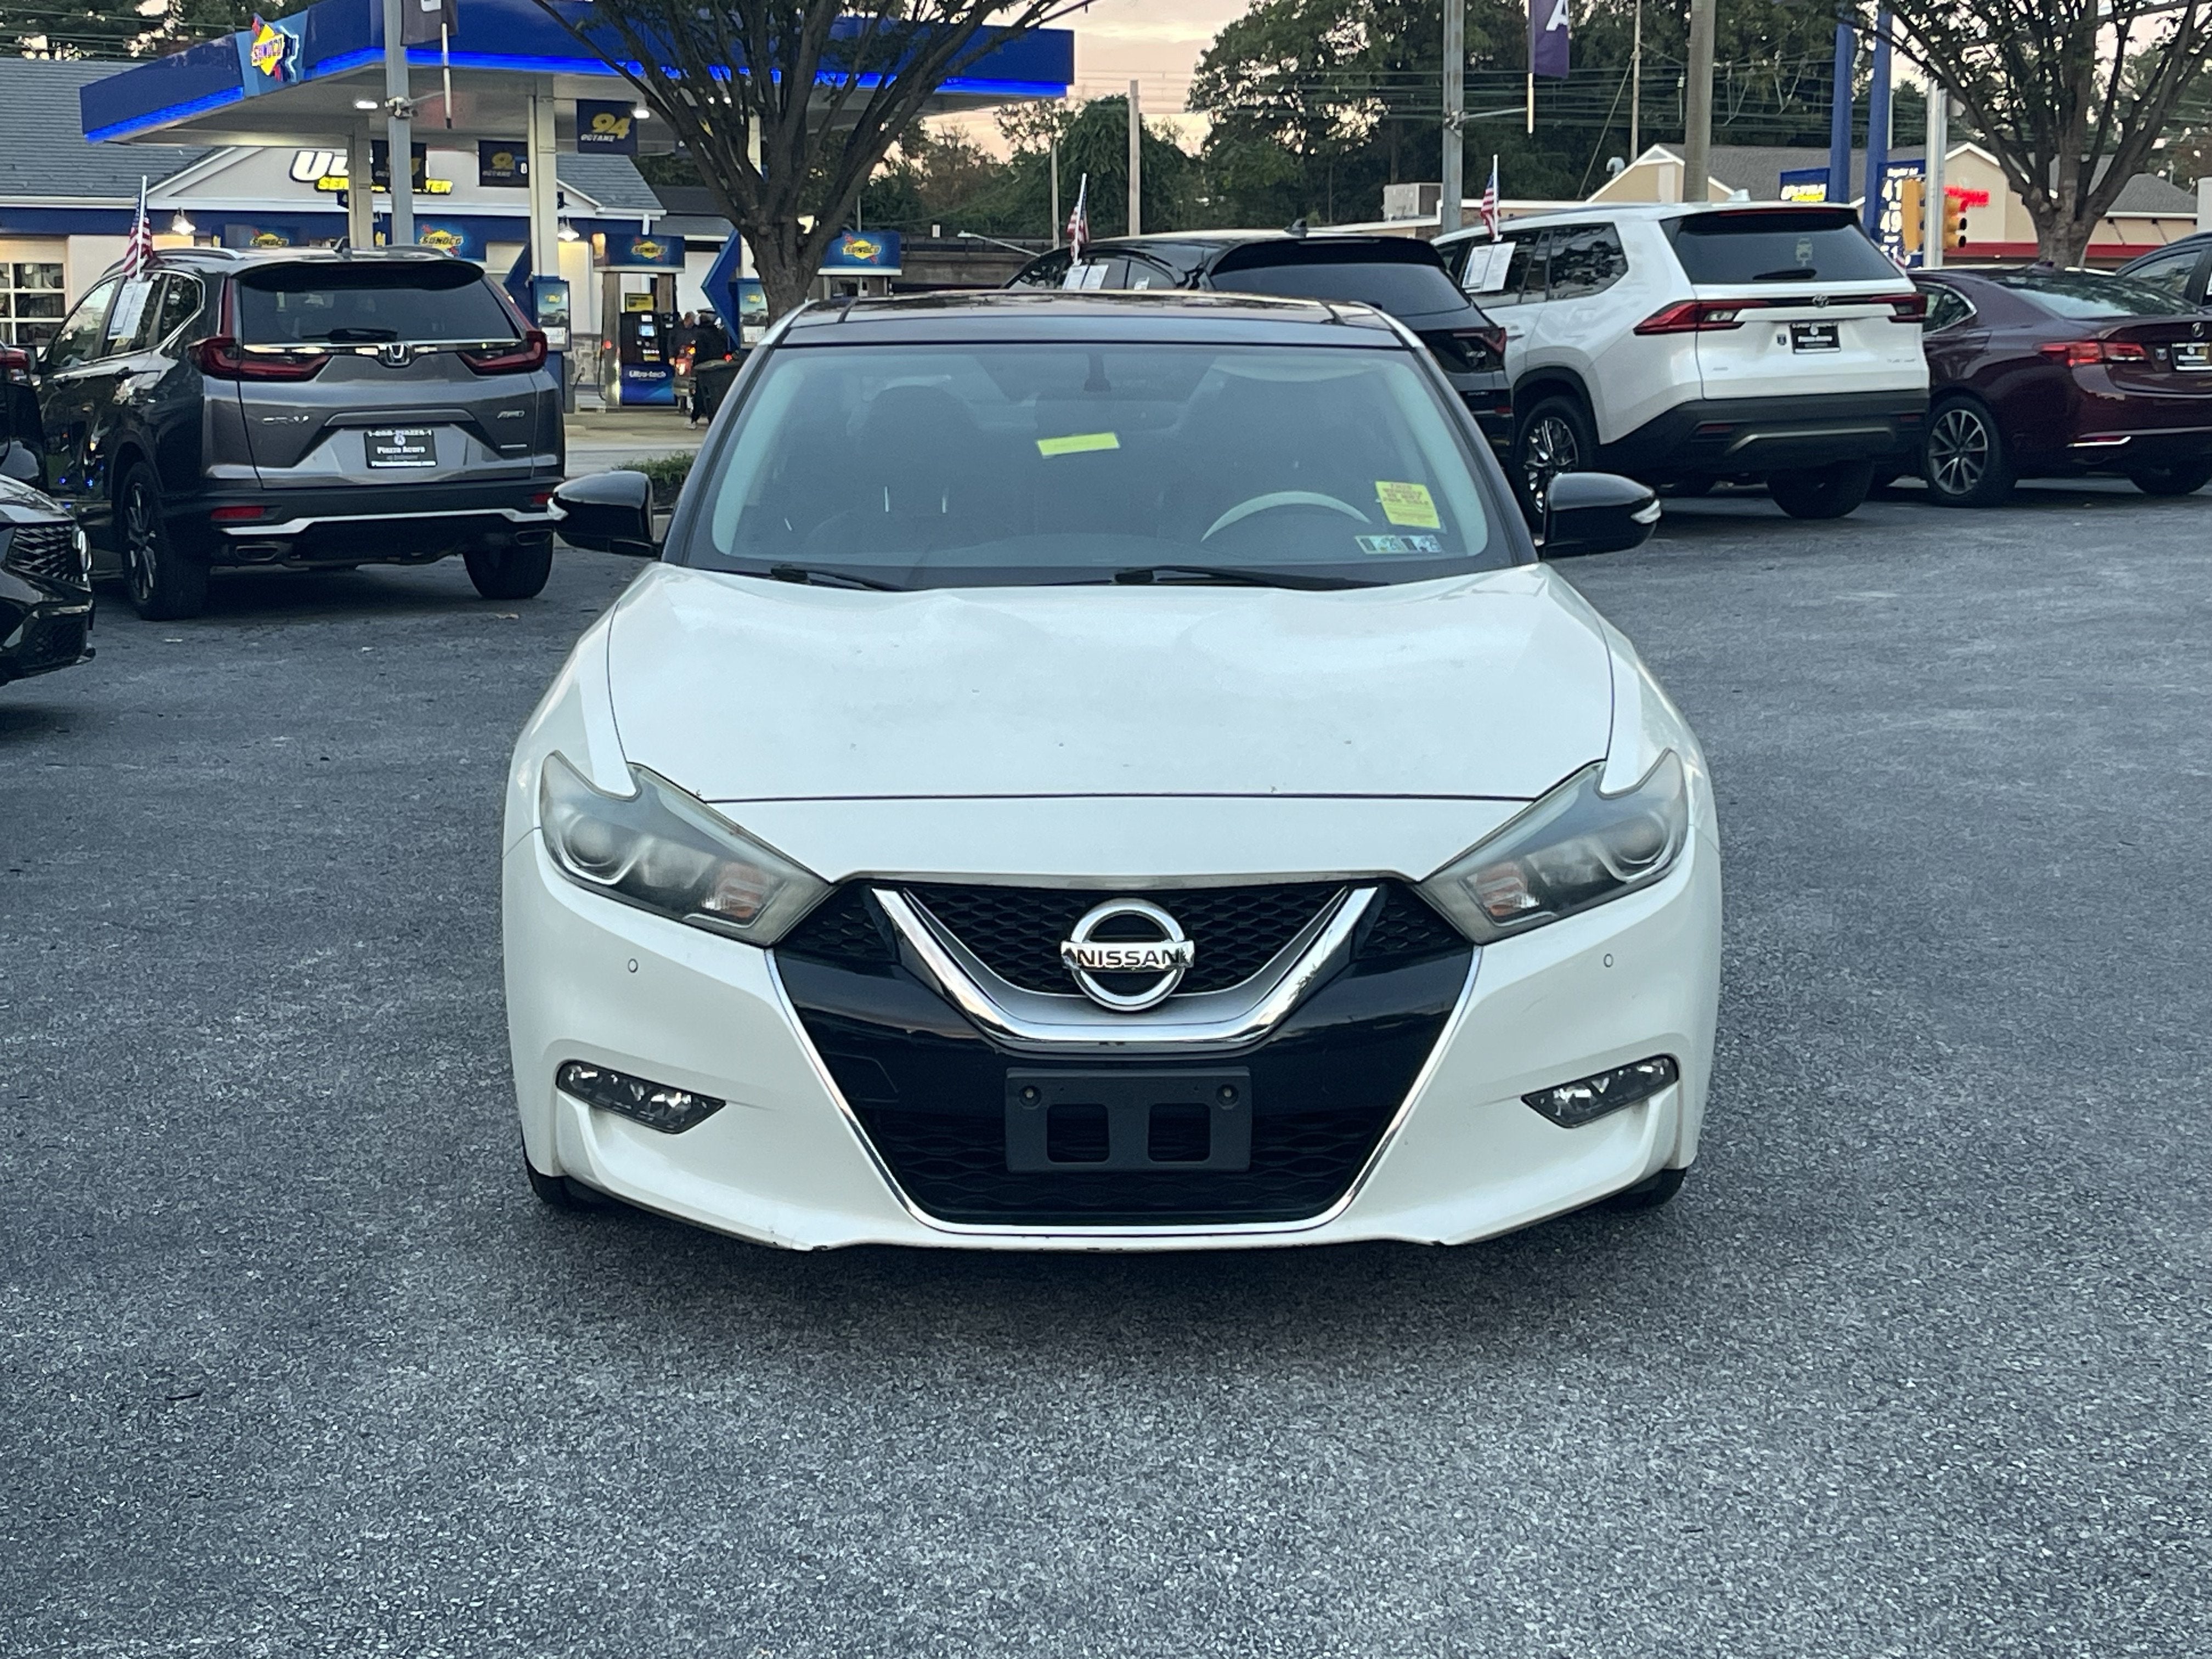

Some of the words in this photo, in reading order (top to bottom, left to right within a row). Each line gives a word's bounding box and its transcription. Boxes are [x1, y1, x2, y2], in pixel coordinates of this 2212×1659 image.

[592, 113, 631, 139] 94
[580, 134, 616, 143] OCTANE
[421, 236, 462, 245] SUNOCO
[1077, 949, 1180, 966] NISSAN
